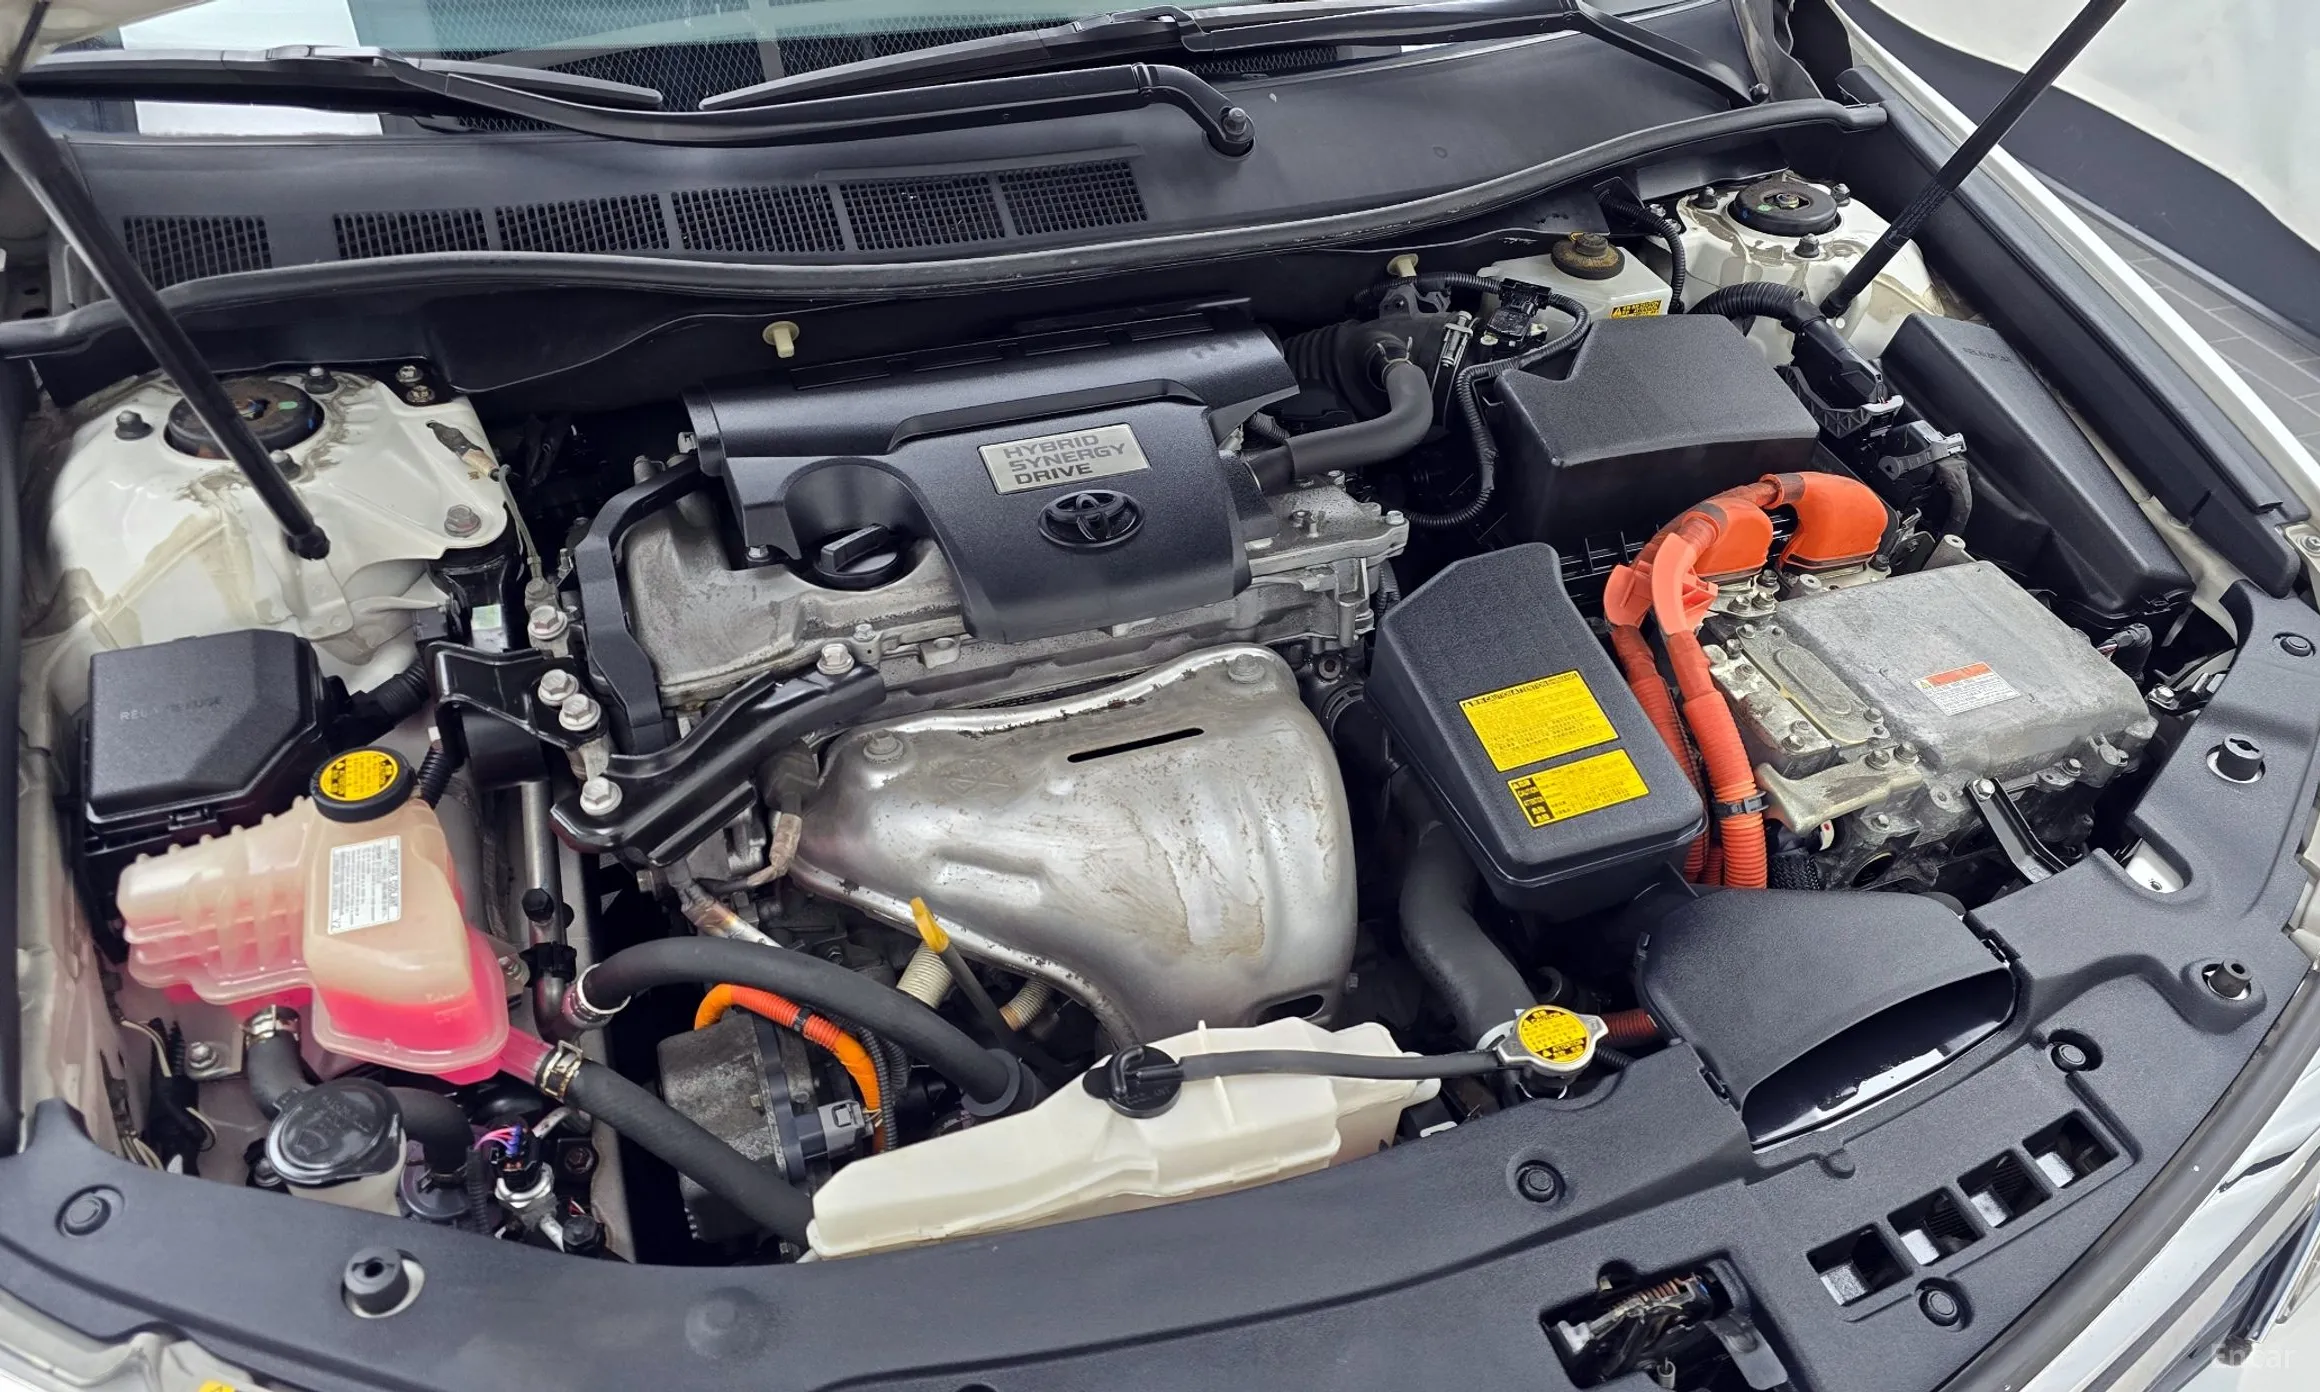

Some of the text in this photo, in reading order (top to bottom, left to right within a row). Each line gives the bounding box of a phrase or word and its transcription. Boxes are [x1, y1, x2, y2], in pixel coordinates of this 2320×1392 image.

[1003, 435, 1099, 459] HYBRID
[1009, 443, 1125, 472] SYNERGY
[1014, 463, 1093, 484] DRIVE
